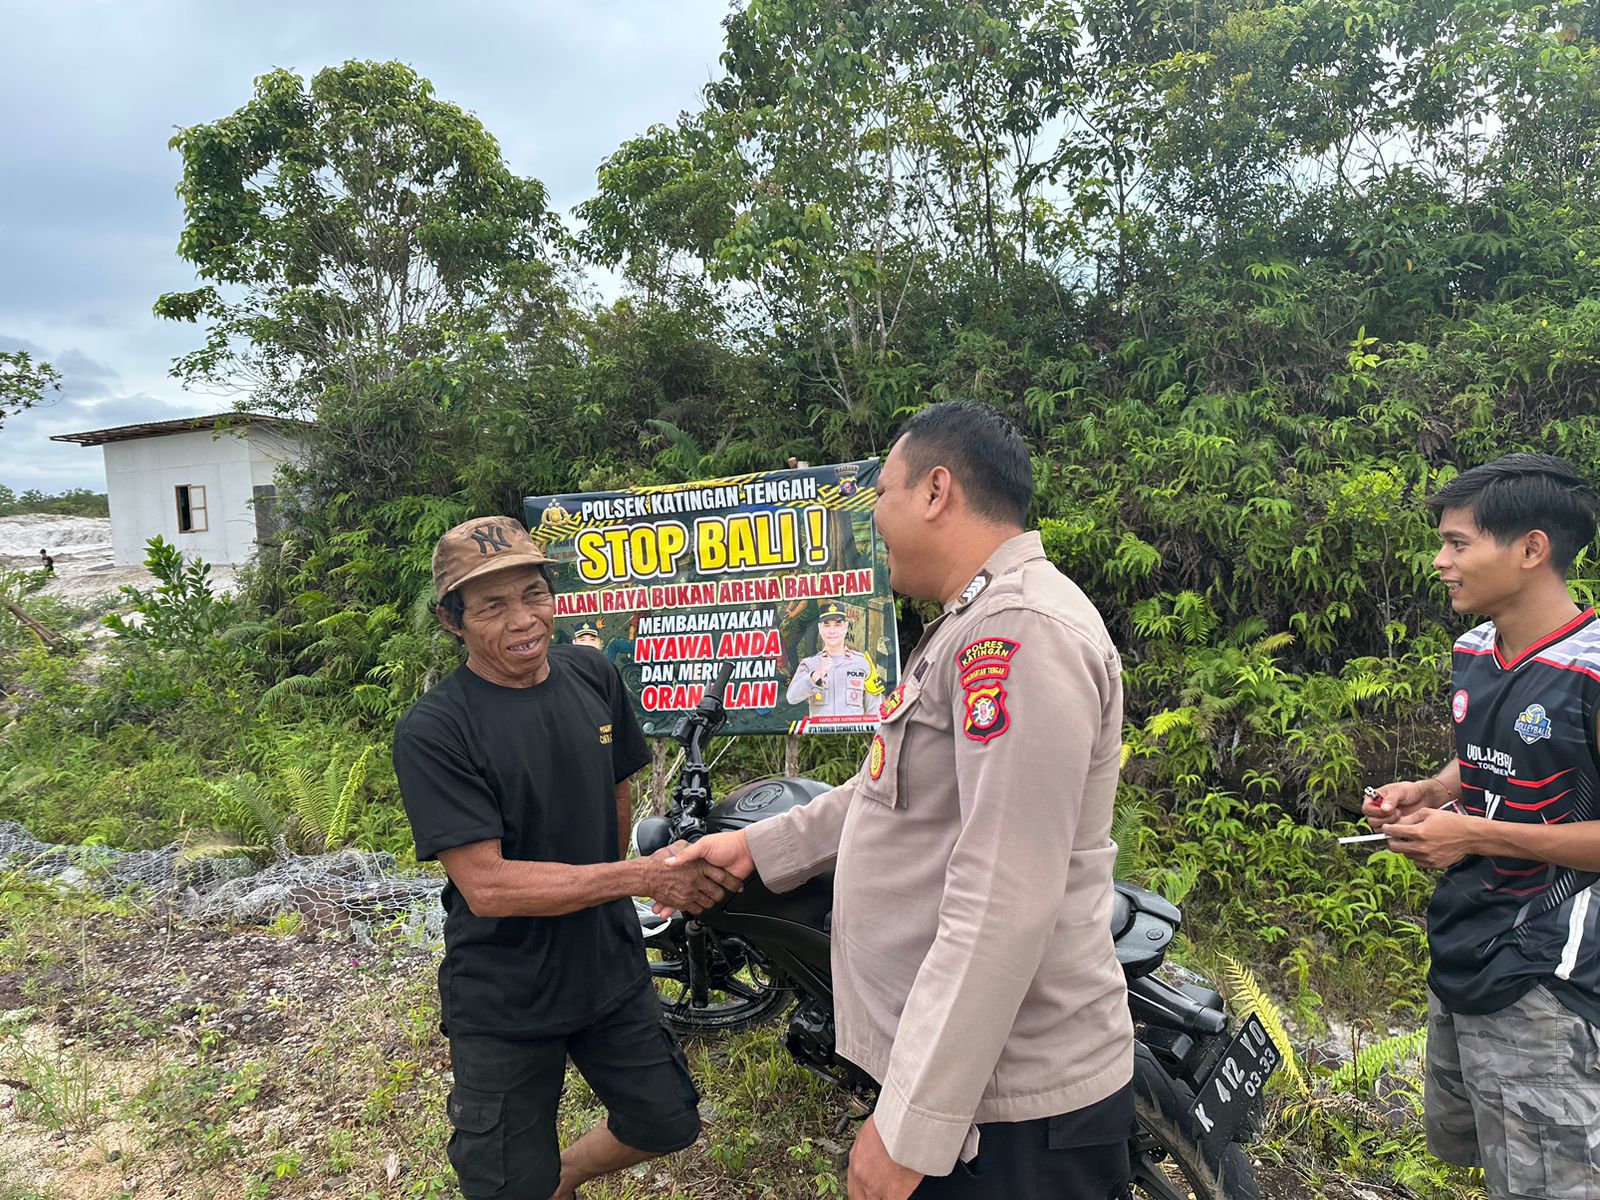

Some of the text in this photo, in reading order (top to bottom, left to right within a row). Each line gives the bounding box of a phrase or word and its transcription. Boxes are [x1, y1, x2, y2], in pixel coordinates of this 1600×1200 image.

[582, 478, 816, 521] POLSEK KATINGAN TENGAH
[577, 522, 688, 582] STOP
[697, 511, 797, 572] BALI
[554, 570, 873, 616] ALAN RAYA BUKAN ARENA BALAPAN
[638, 610, 774, 634] MEMBAHAYAKAN
[636, 630, 781, 662] NYAWA ANDA
[962, 648, 1009, 666] KATINGAN
[966, 640, 1004, 657] POLRES
[641, 660, 776, 682] DAN MERUIKAN
[642, 682, 777, 711] ORAN LAIN
[1194, 1103, 1214, 1133] K
[1215, 1057, 1245, 1103] 412
